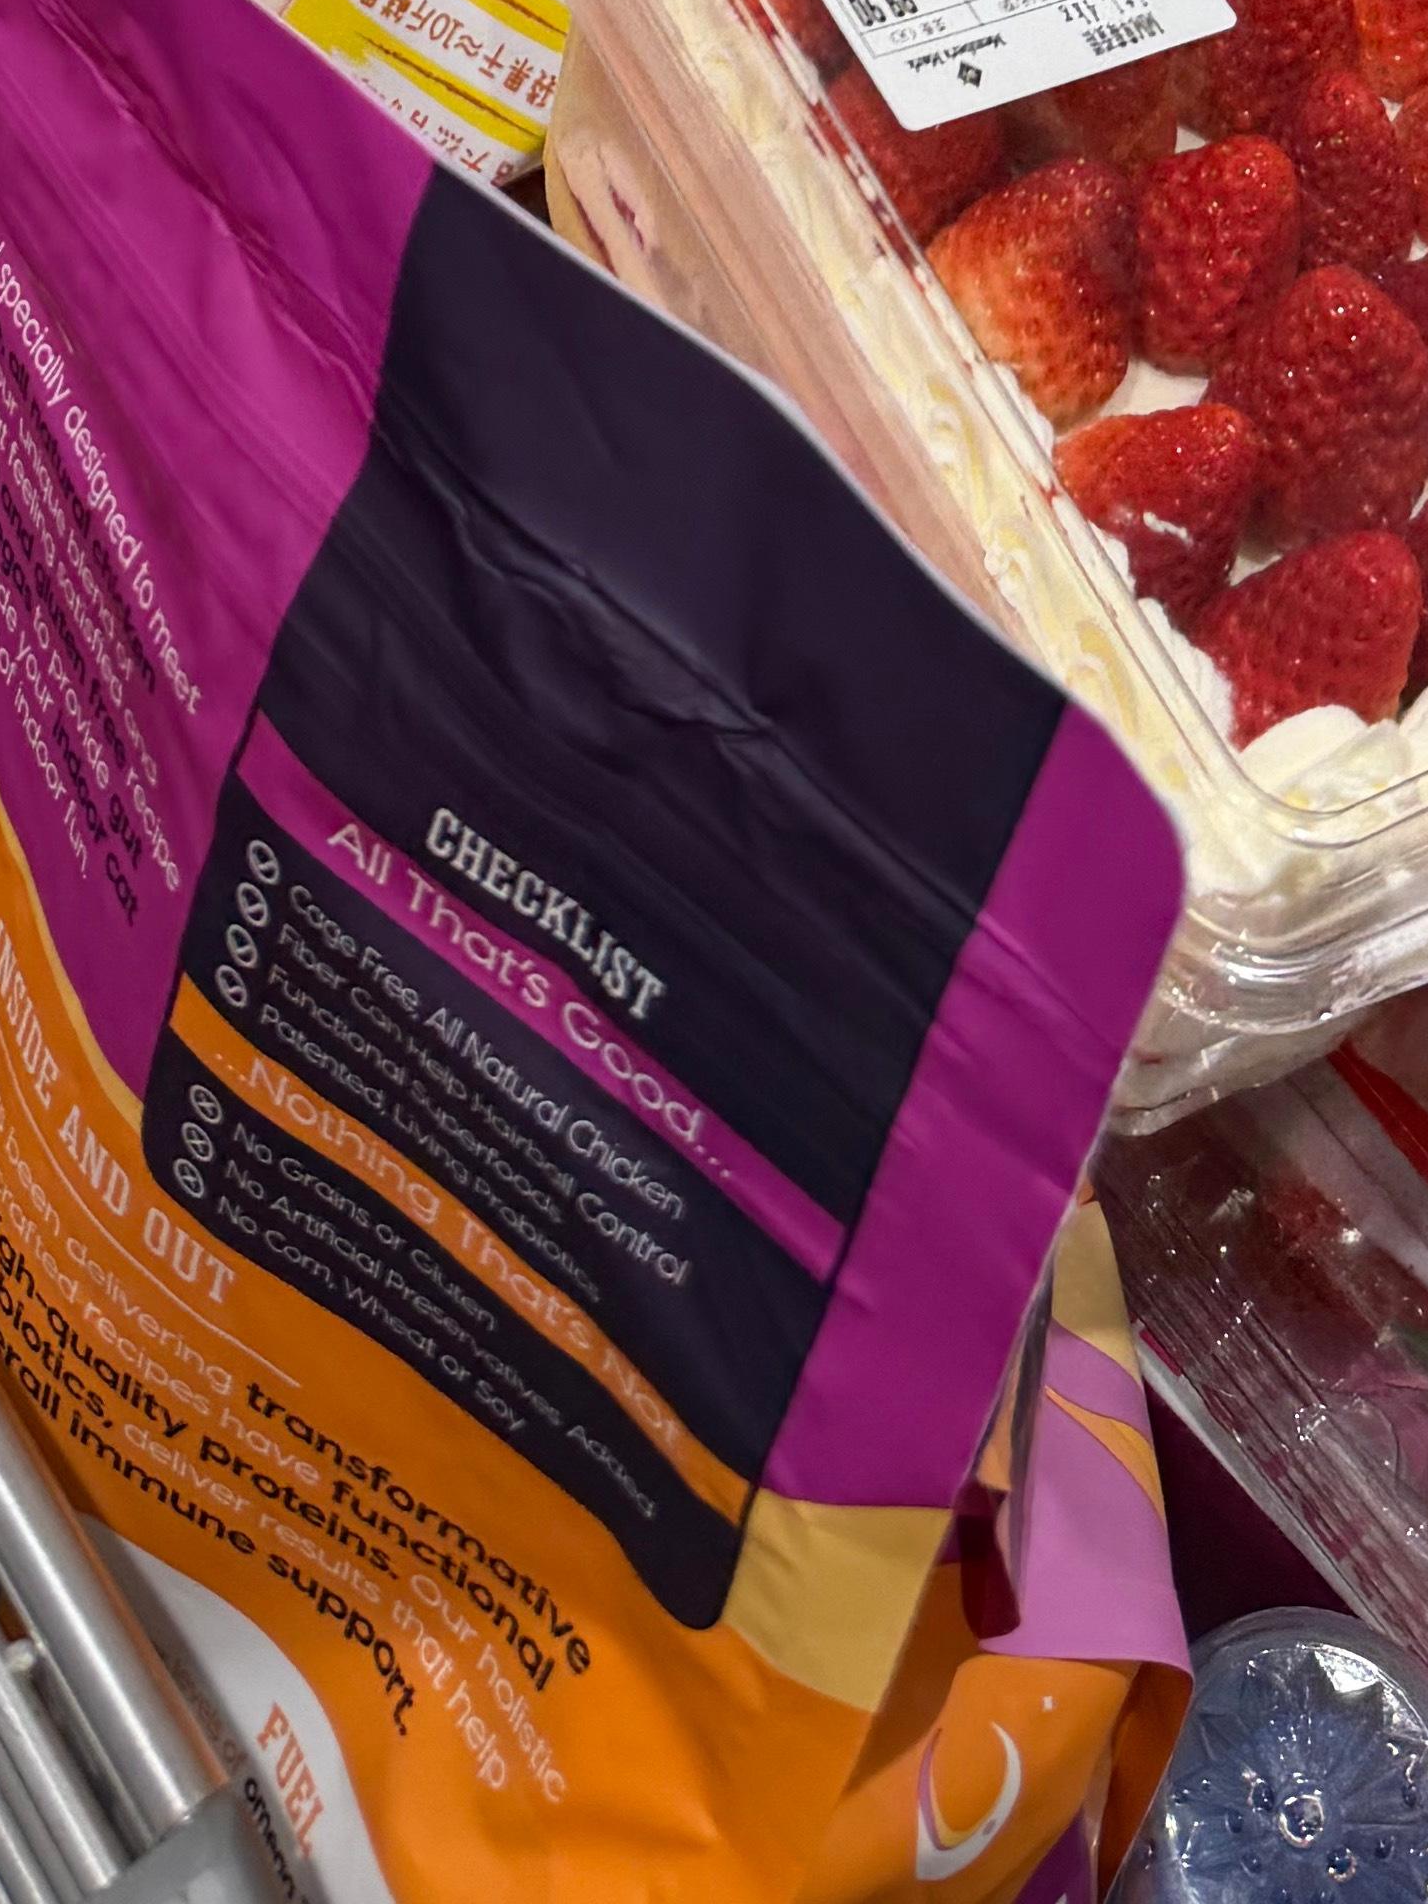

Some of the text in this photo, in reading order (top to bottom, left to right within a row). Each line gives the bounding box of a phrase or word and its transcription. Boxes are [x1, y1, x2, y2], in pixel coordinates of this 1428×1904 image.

[64, 405, 144, 567] designed
[149, 610, 202, 715] meet
[326, 819, 554, 1010] All That's
[424, 806, 671, 1022] CHECKLIST
[58, 1105, 130, 1218] AND
[142, 1206, 237, 1305] OUT
[565, 1116, 687, 1221] Chicken
[576, 1189, 692, 1289] Control
[65, 1238, 234, 1396] delivering
[246, 1380, 593, 1677] transformative
[82, 1301, 211, 1417] recipes
[331, 1478, 555, 1694] functional
[198, 1432, 400, 1583] proteins.
[66, 1409, 279, 1556] immune
[266, 1550, 418, 1738] support.
